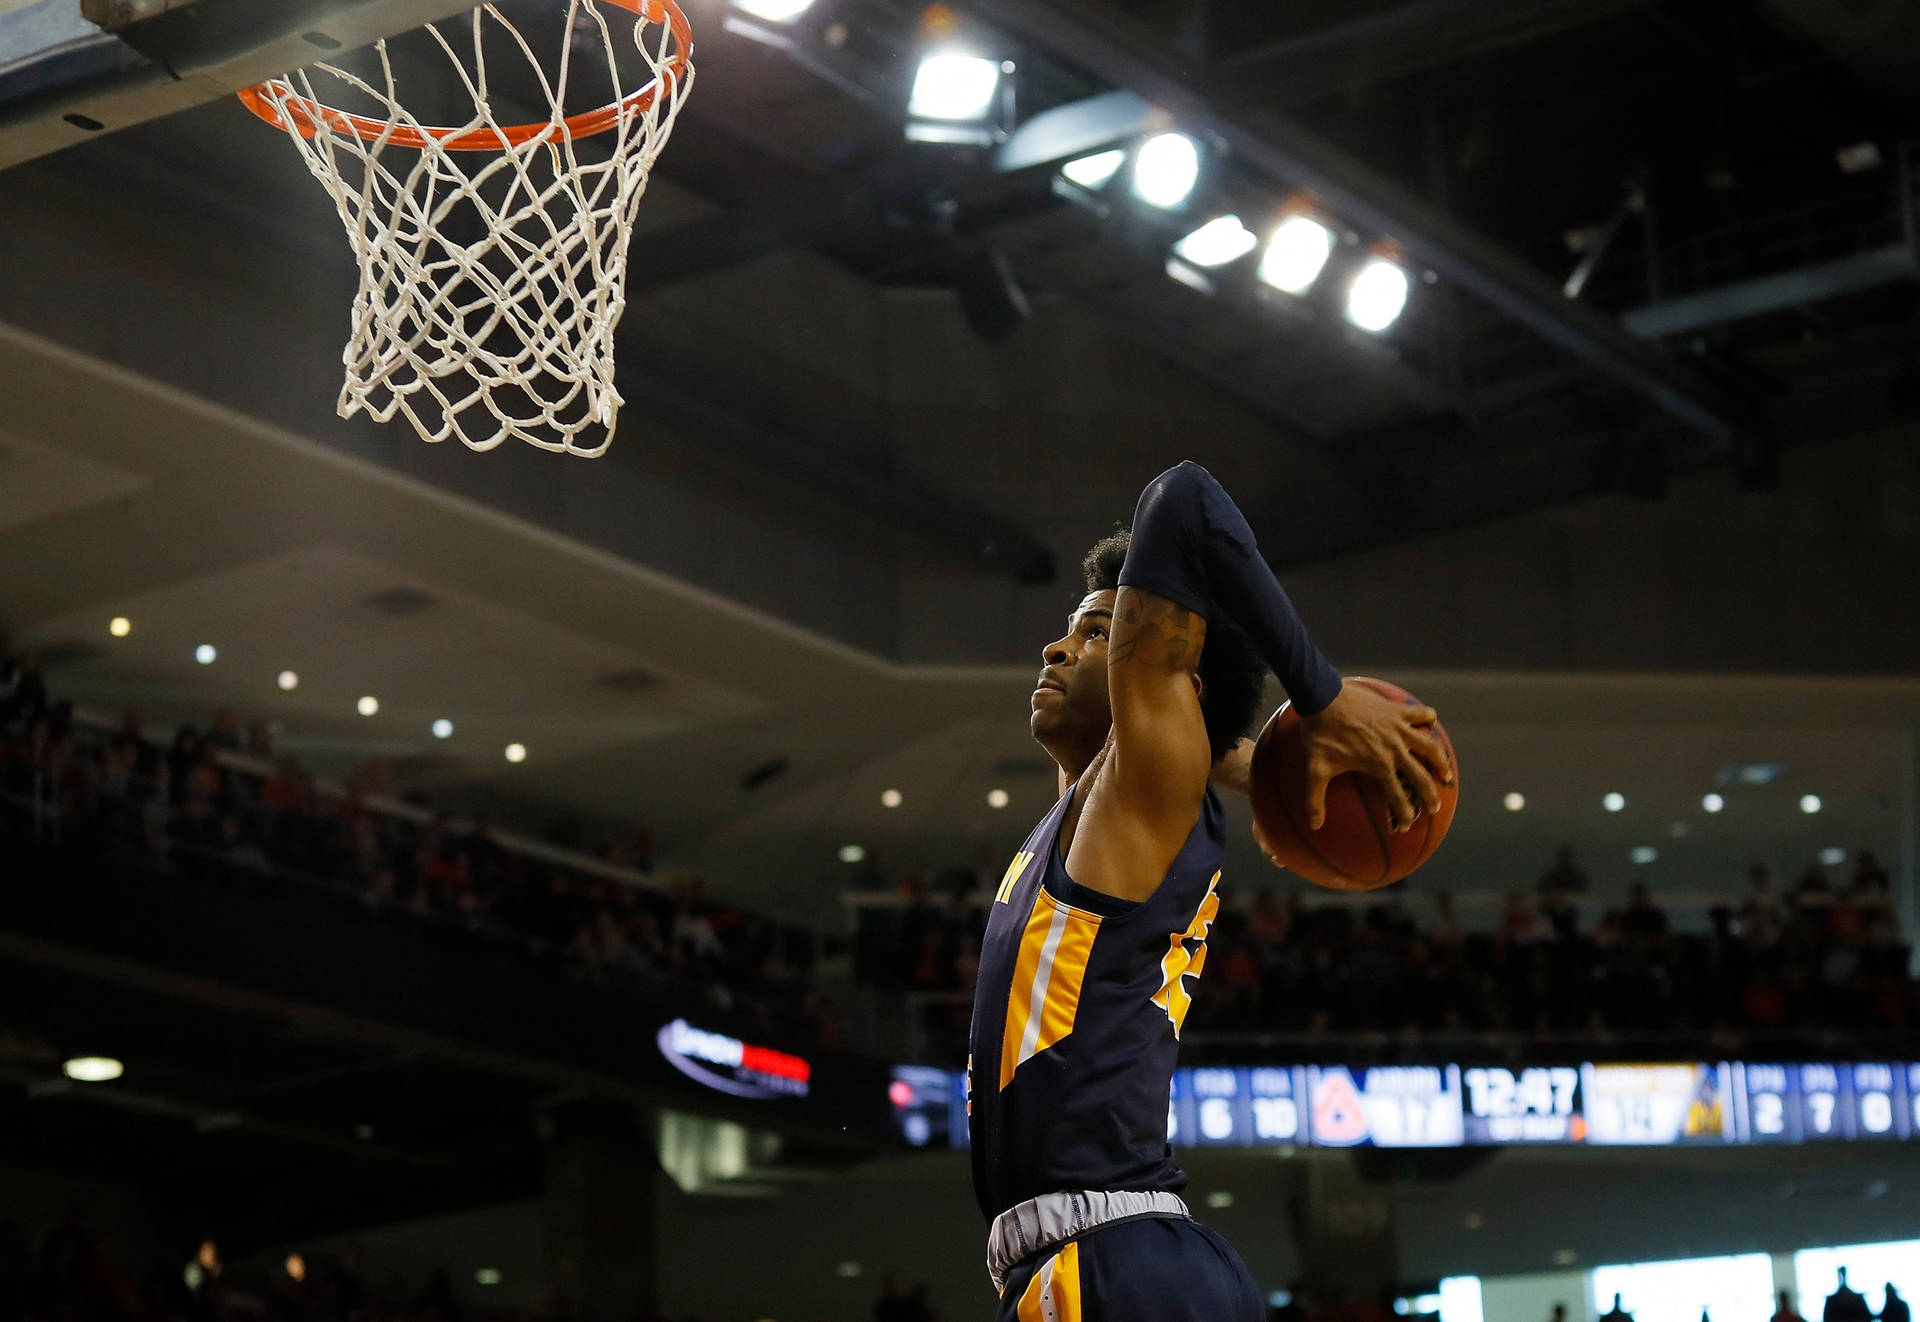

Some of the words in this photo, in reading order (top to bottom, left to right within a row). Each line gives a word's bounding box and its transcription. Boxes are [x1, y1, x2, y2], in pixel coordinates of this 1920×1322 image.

[1467, 1068, 1577, 1117] 12:47
[1754, 1092, 1784, 1134] 2
[1807, 1092, 1836, 1133] 7
[1202, 1098, 1233, 1139] 6
